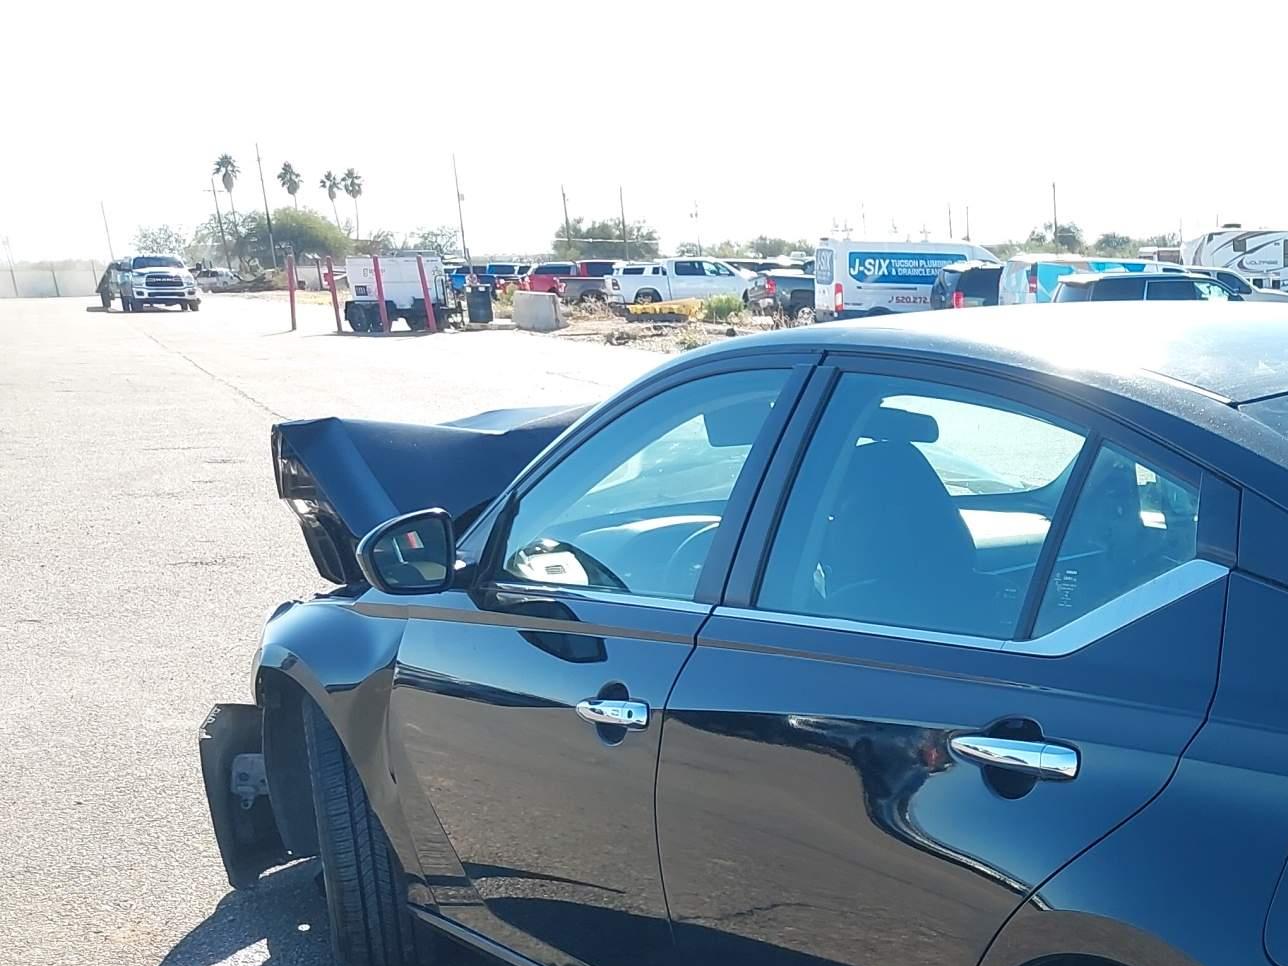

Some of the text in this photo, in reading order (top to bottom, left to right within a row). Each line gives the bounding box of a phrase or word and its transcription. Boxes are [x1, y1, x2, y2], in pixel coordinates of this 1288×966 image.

[850, 258, 889, 276] J-SIX
[891, 259, 919, 268] TUCSON
[891, 268, 897, 276] &
